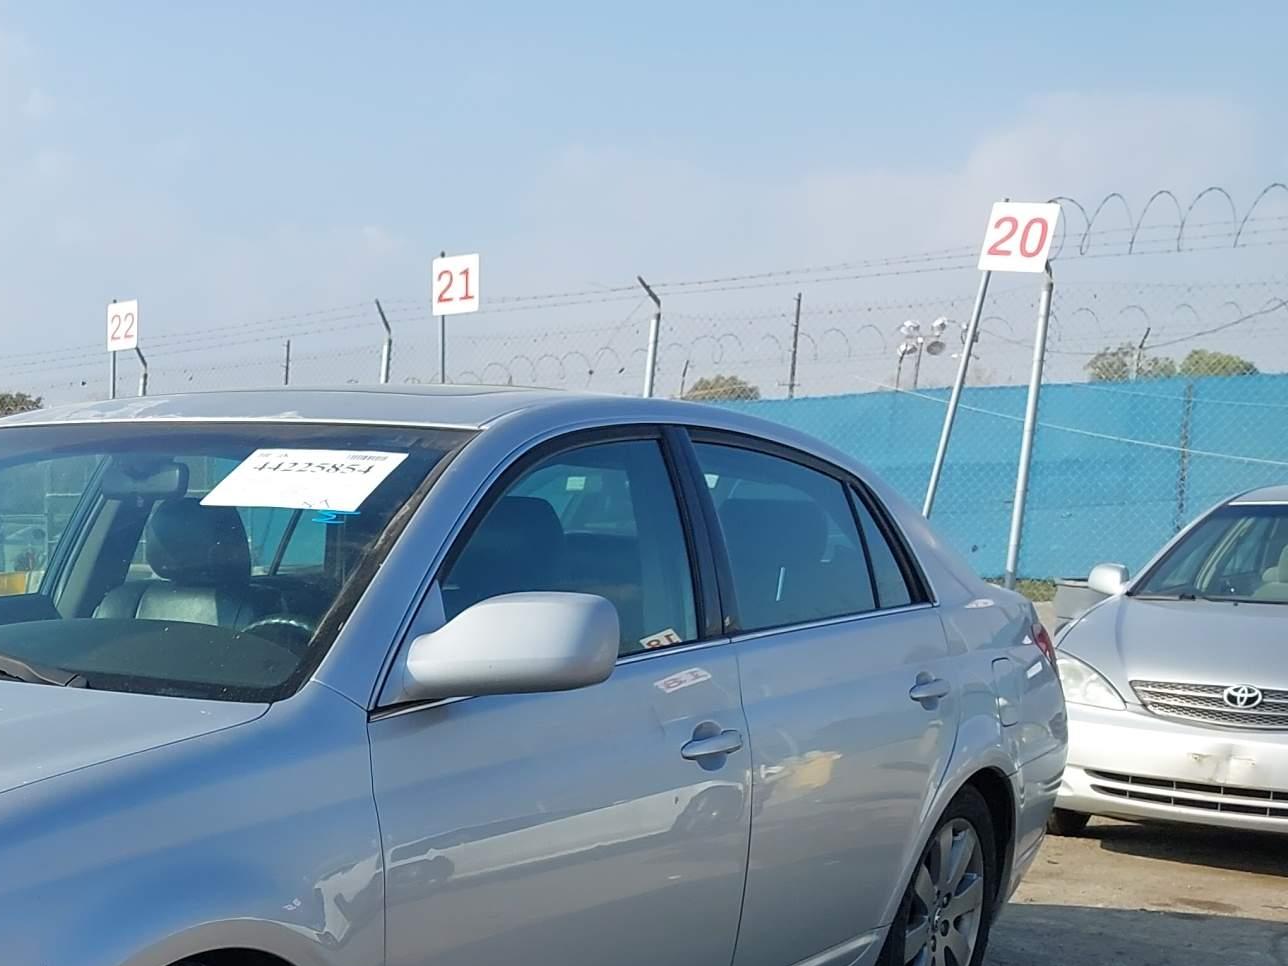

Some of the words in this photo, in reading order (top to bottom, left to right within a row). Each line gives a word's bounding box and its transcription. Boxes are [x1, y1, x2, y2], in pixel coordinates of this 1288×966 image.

[987, 216, 1048, 258] 20
[437, 267, 474, 303] 21
[111, 312, 134, 340] 22
[253, 461, 375, 475] 44225854
